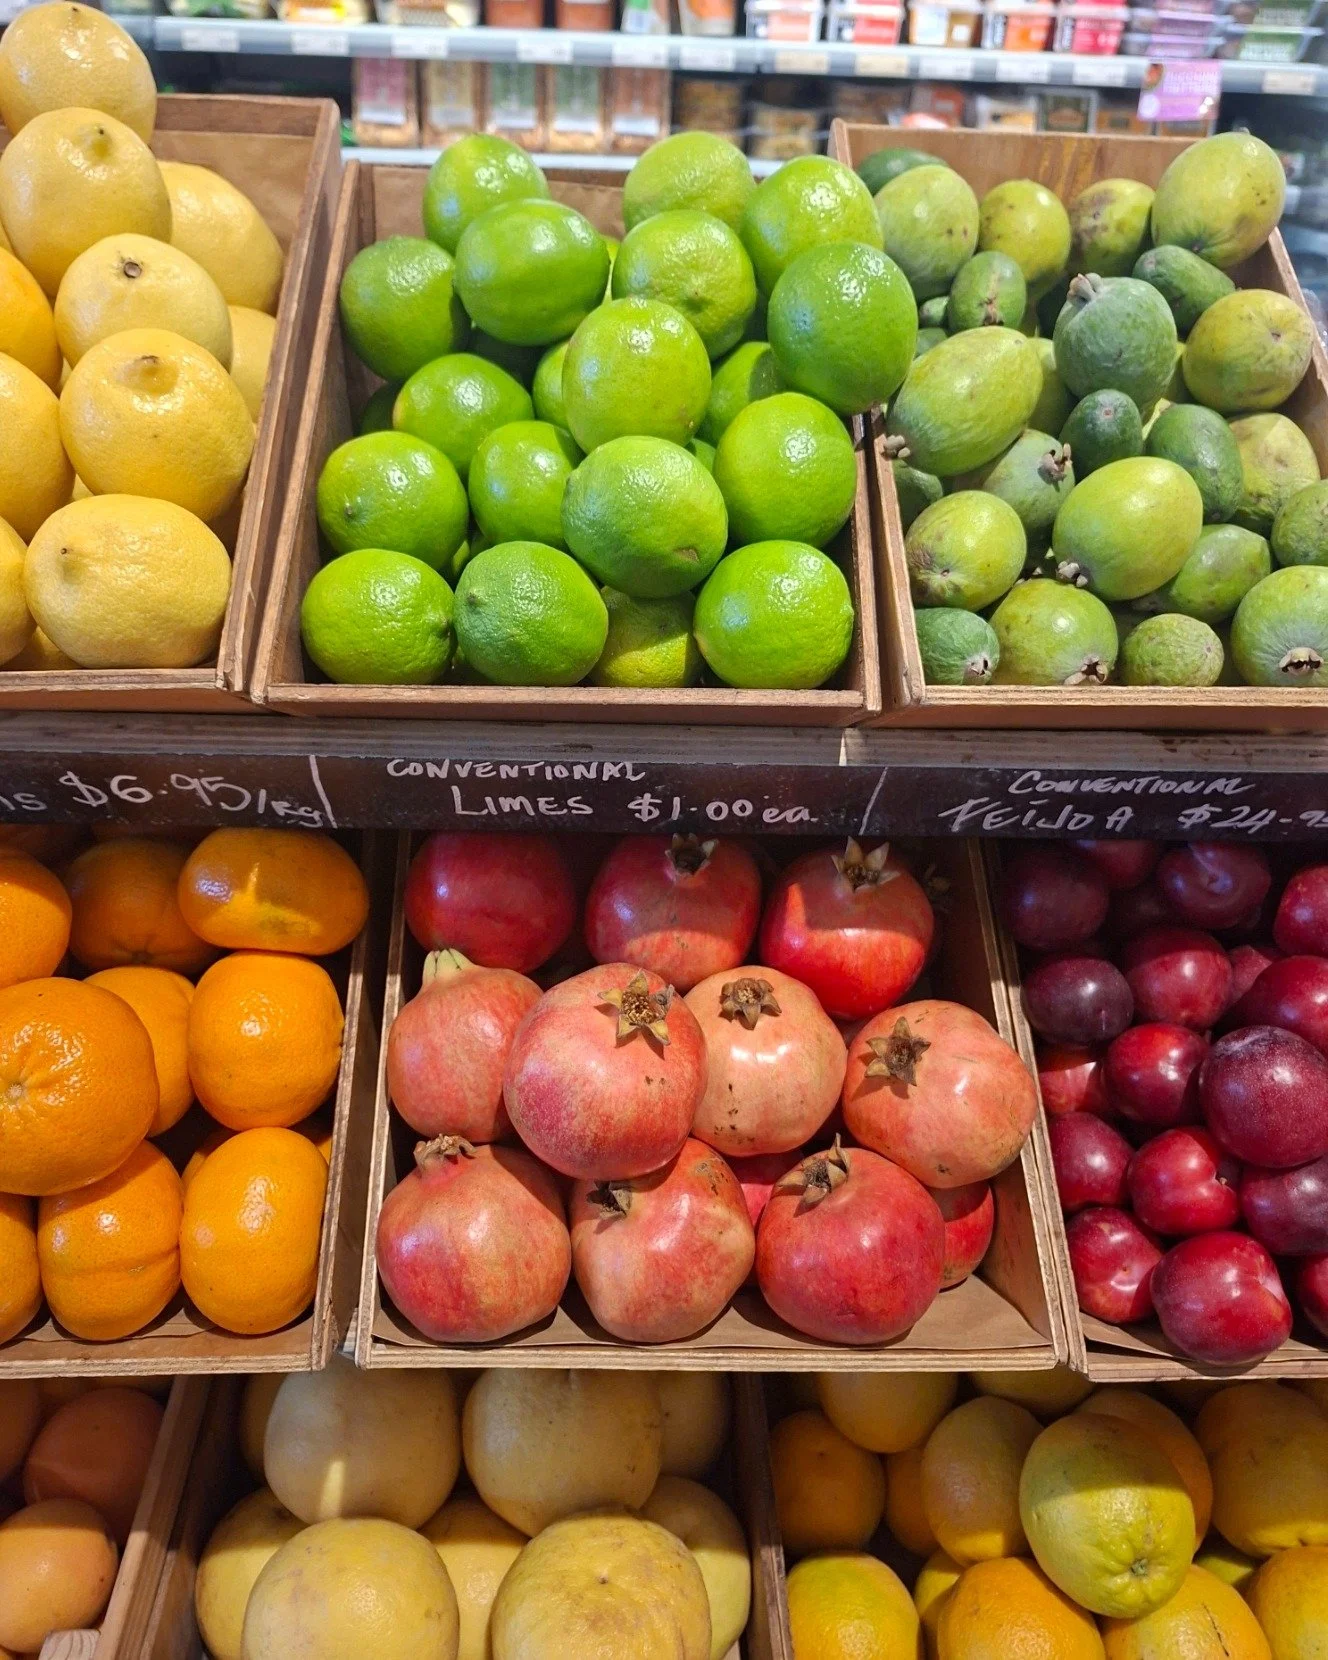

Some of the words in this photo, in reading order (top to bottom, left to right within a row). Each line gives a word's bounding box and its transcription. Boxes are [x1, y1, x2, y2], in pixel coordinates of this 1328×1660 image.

[386, 757, 646, 782] CONVENTIONAL
[1008, 770, 1256, 796] CONVENTIONAL
[450, 785, 594, 816] LIMES
